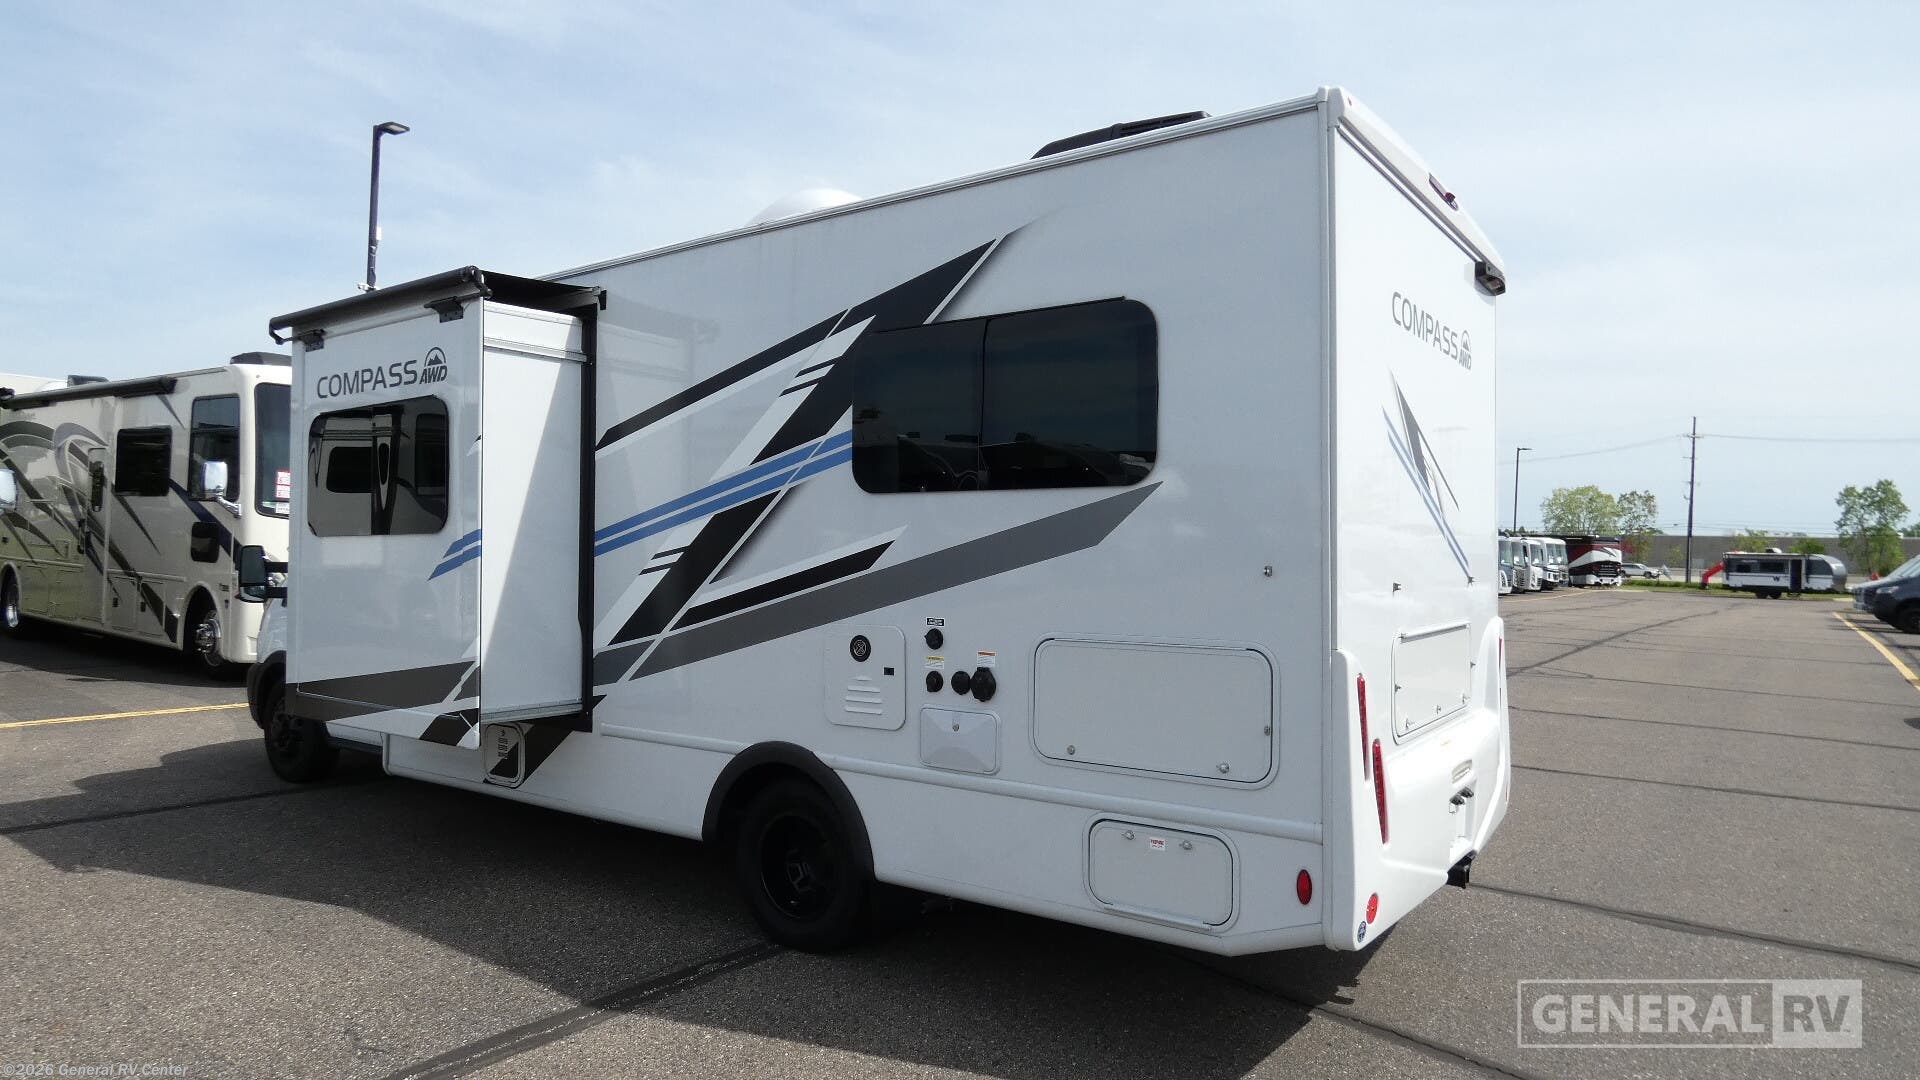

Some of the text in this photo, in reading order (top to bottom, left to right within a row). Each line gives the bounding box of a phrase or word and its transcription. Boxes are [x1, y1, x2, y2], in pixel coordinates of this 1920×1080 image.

[1392, 291, 1472, 371] COMPASS AWD
[317, 360, 448, 398] COMPASS AWD
